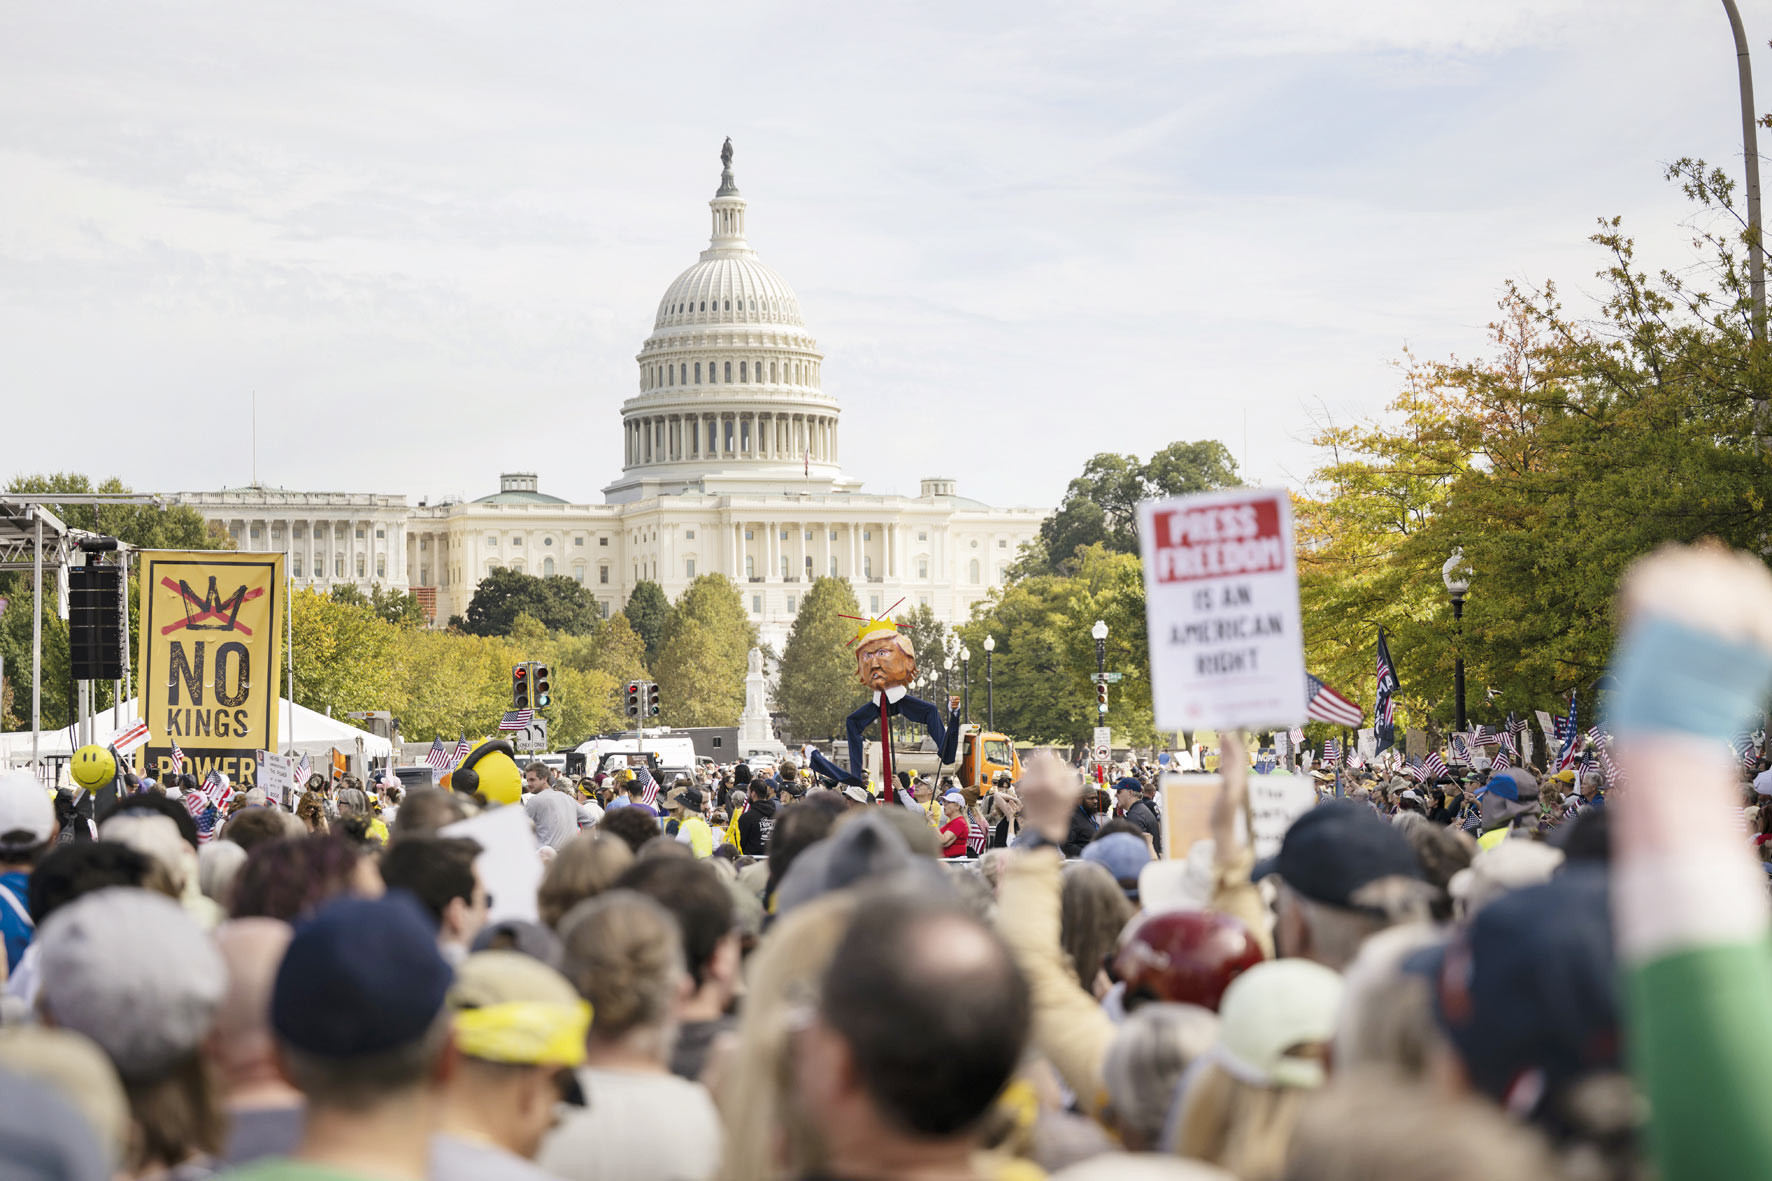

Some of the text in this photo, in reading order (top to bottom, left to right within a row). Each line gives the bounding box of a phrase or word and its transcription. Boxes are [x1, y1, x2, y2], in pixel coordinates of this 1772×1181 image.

[1168, 505, 1259, 547] PRESS
[1158, 536, 1283, 580] FREEDOM
[1193, 585, 1252, 611] IS AN
[1170, 615, 1283, 644] AMERICAN
[168, 641, 250, 707] NO
[1196, 648, 1257, 675] RIGHT
[167, 708, 248, 738] KINGS
[1258, 752, 1276, 762] NOPE
